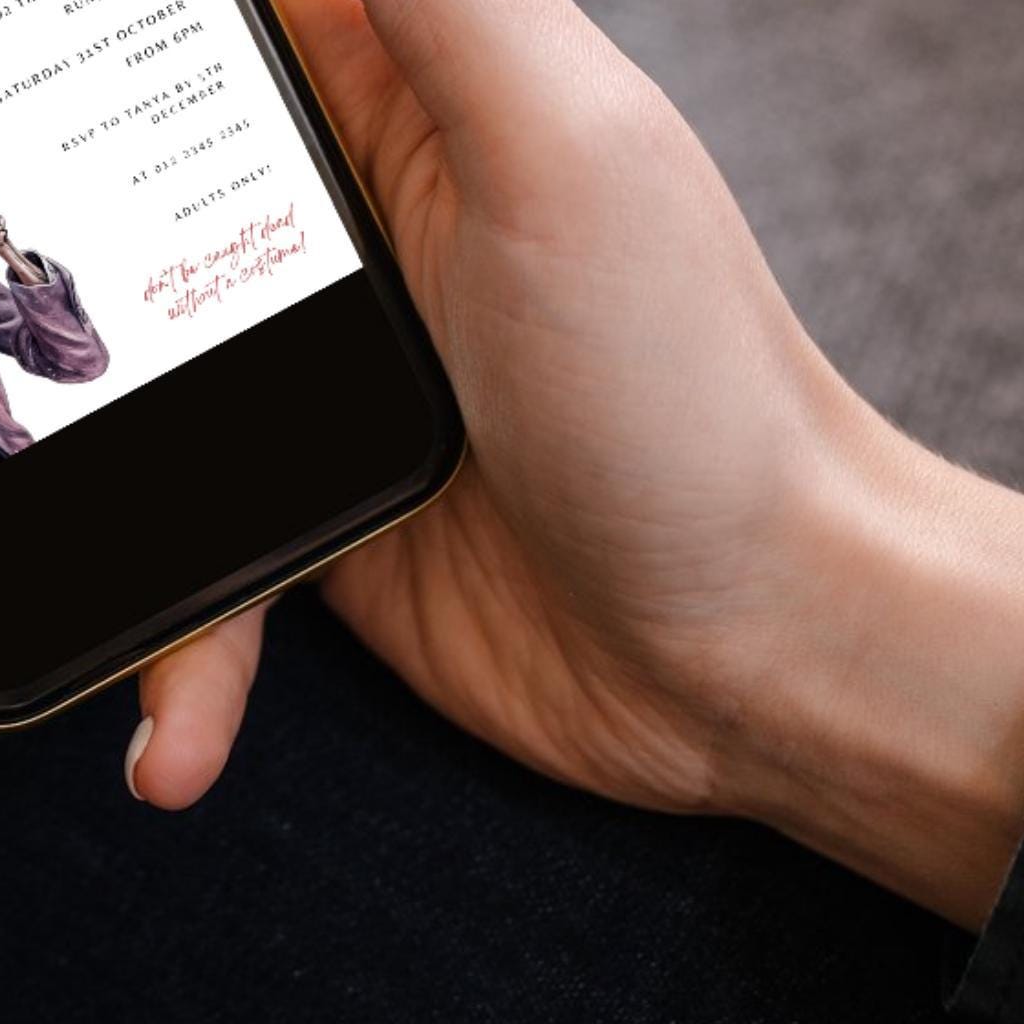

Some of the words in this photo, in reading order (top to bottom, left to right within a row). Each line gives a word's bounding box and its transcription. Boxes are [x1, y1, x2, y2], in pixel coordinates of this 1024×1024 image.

[76, 36, 110, 65] 31ST
[116, 0, 187, 41] OCTOBER
[125, 39, 168, 68] FROM
[172, 21, 204, 44] 6PM
[61, 128, 95, 152] RSVP
[99, 117, 120, 130] TO
[124, 91, 170, 119] TANYA
[151, 80, 224, 125] DECEMBER
[175, 188, 225, 222] ADULTS
[204, 222, 260, 270] caught
[168, 274, 225, 320] without
